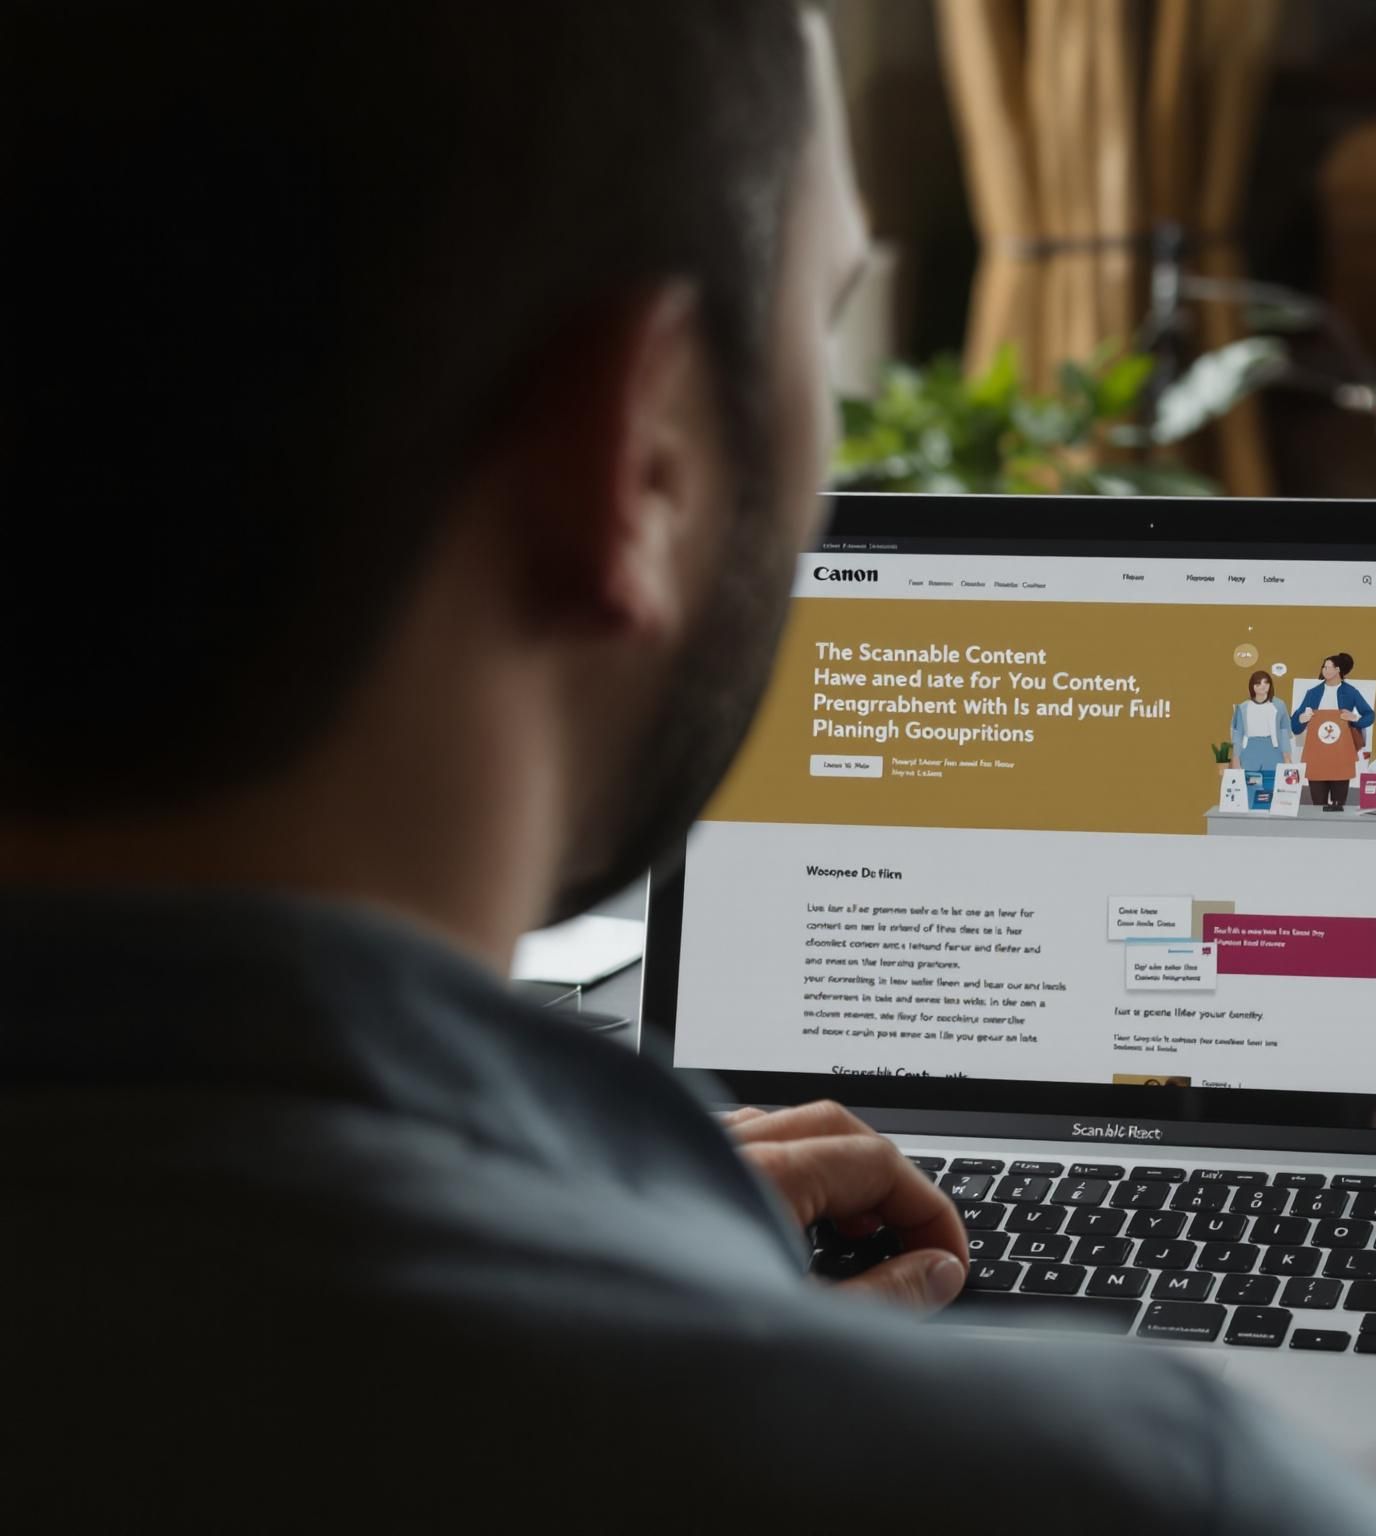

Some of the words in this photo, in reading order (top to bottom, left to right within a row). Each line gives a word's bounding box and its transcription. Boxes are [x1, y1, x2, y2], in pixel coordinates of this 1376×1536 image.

[813, 566, 879, 582] Canon
[815, 641, 853, 661] The
[859, 643, 960, 664] Scannable
[965, 645, 1047, 665] Content
[872, 669, 922, 688] aned
[970, 671, 1001, 689] for
[1009, 671, 1047, 690] You
[1052, 672, 1141, 694] Content,
[1036, 697, 1073, 716] and
[1077, 702, 1124, 721] your
[812, 718, 899, 743] Planingh
[1209, 1219, 1224, 1230] U
[1282, 1254, 1296, 1265] K
[1168, 1278, 1189, 1290] M
